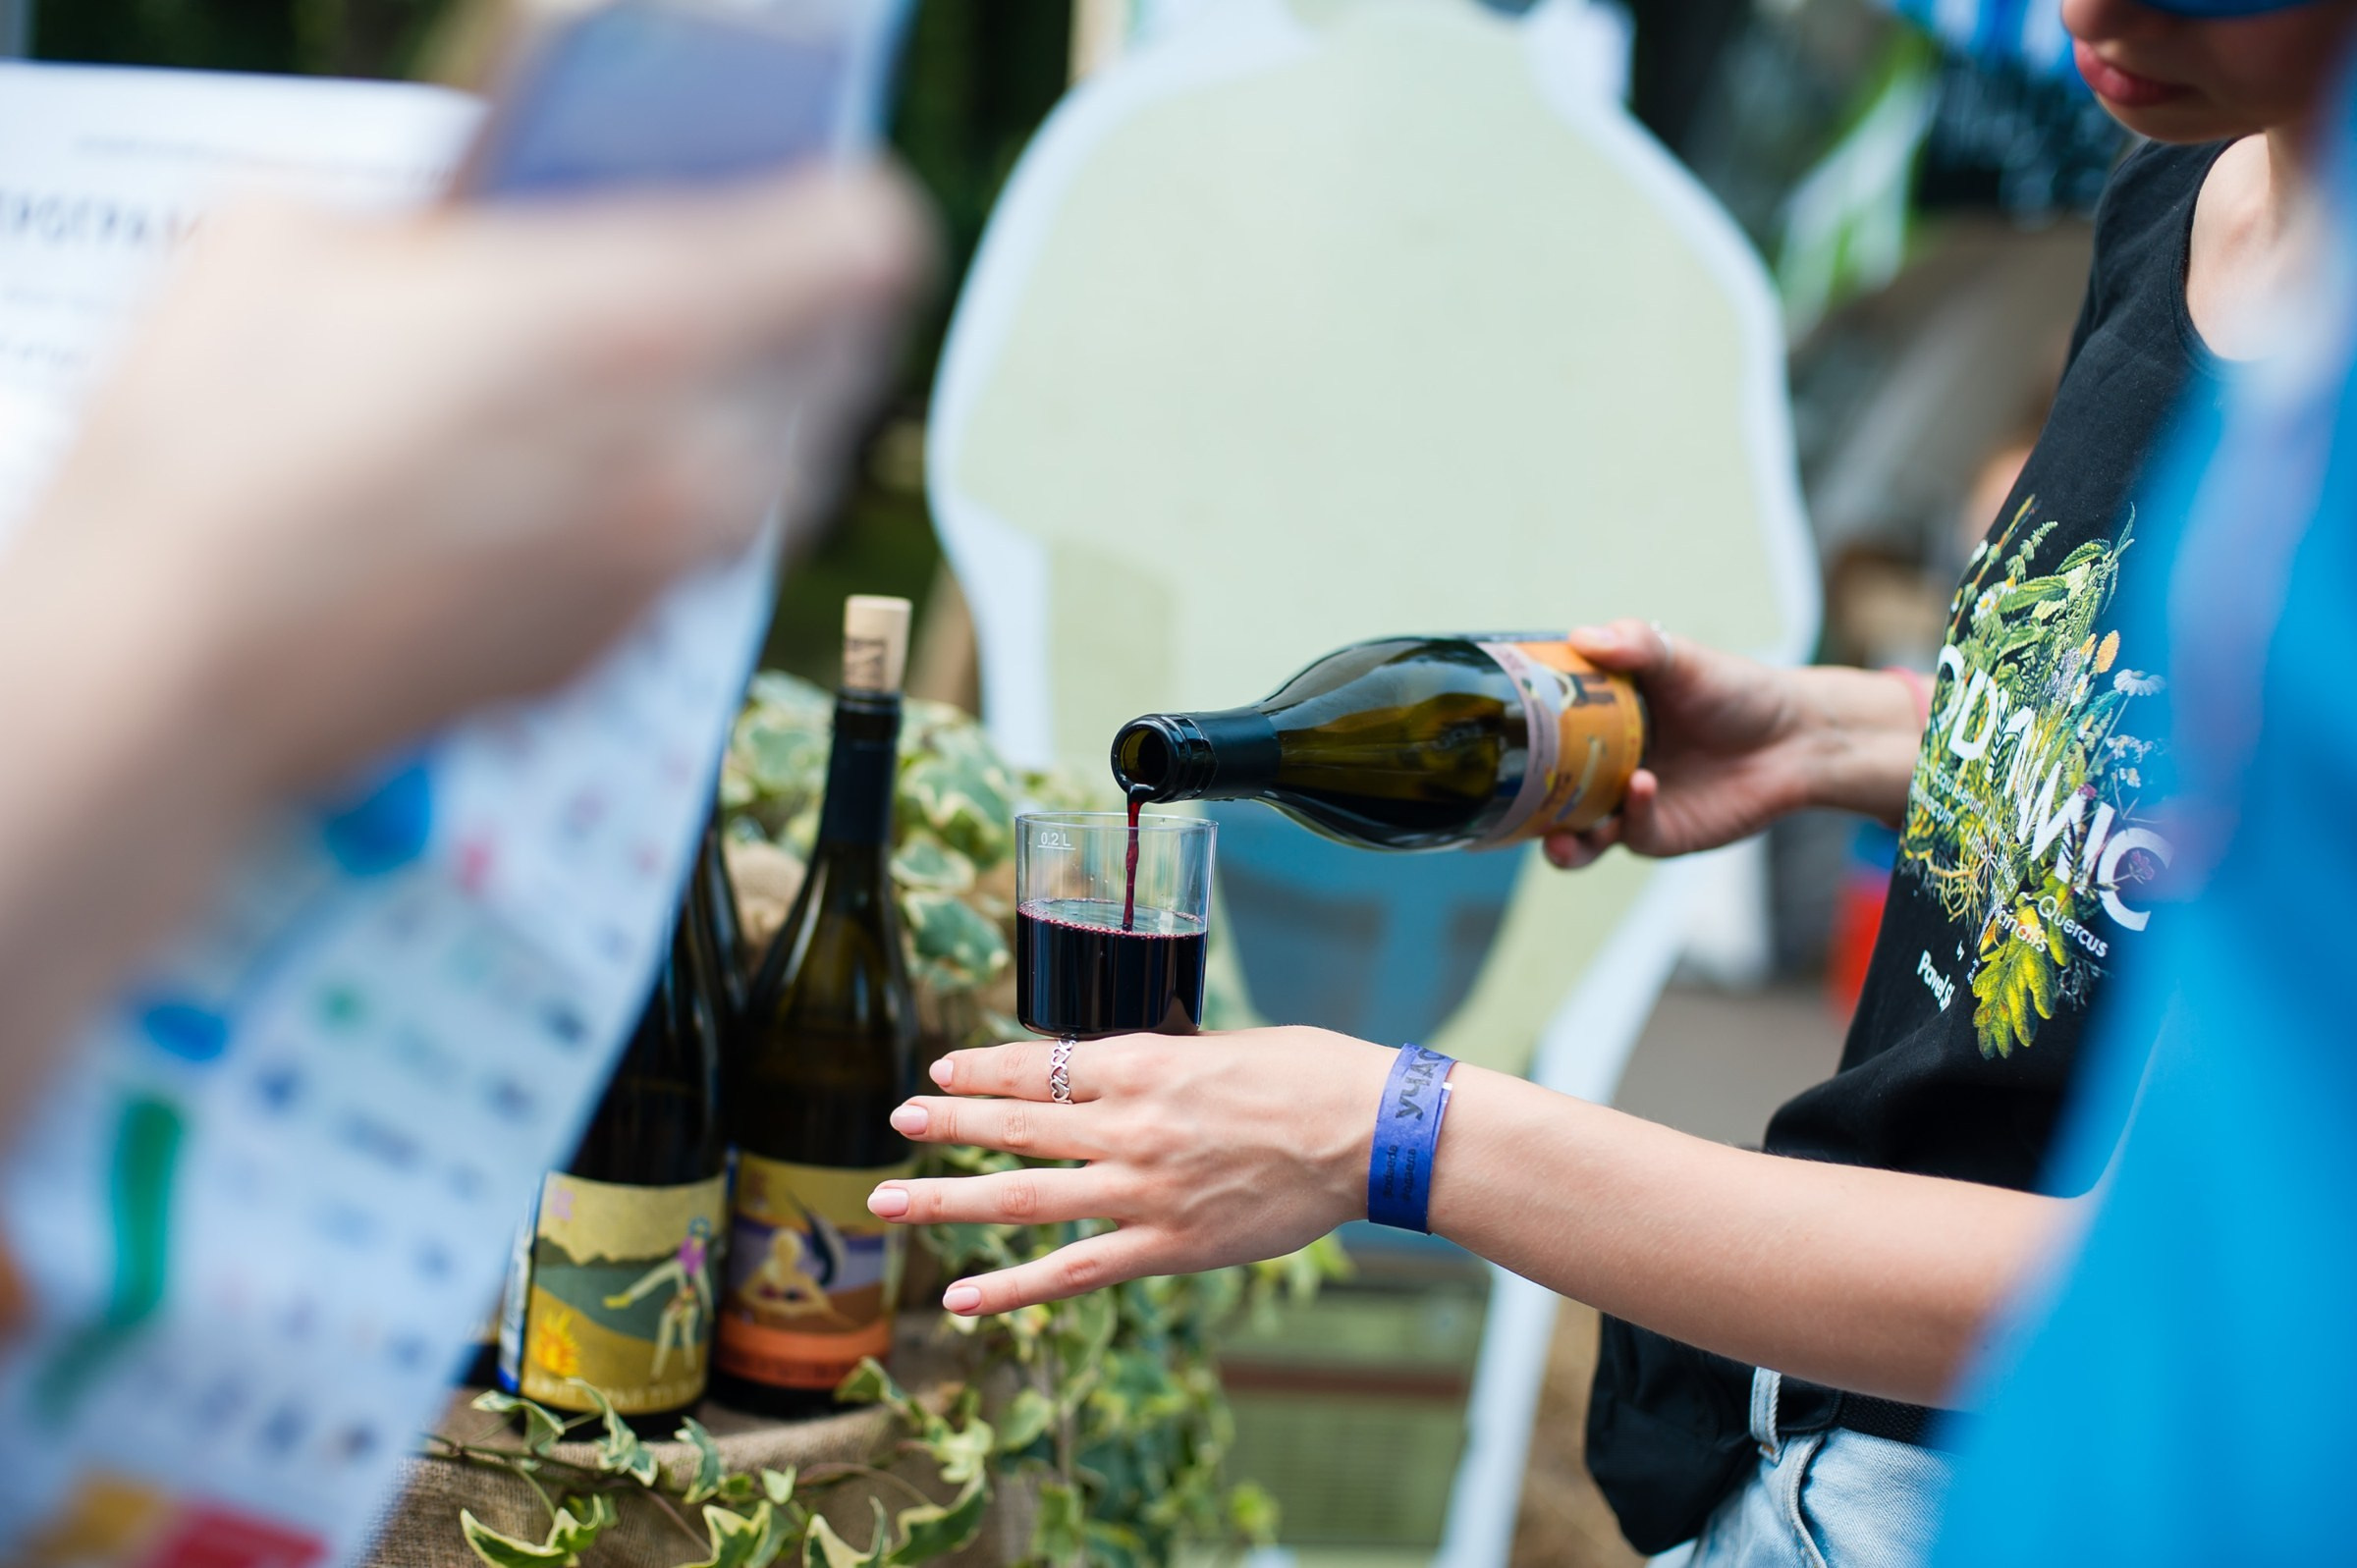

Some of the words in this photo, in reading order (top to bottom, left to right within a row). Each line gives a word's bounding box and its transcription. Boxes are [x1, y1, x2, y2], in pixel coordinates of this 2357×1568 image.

[1040, 833, 1060, 846] 0.2
[1063, 833, 1071, 847] L
[2038, 894, 2109, 958] Quercus
